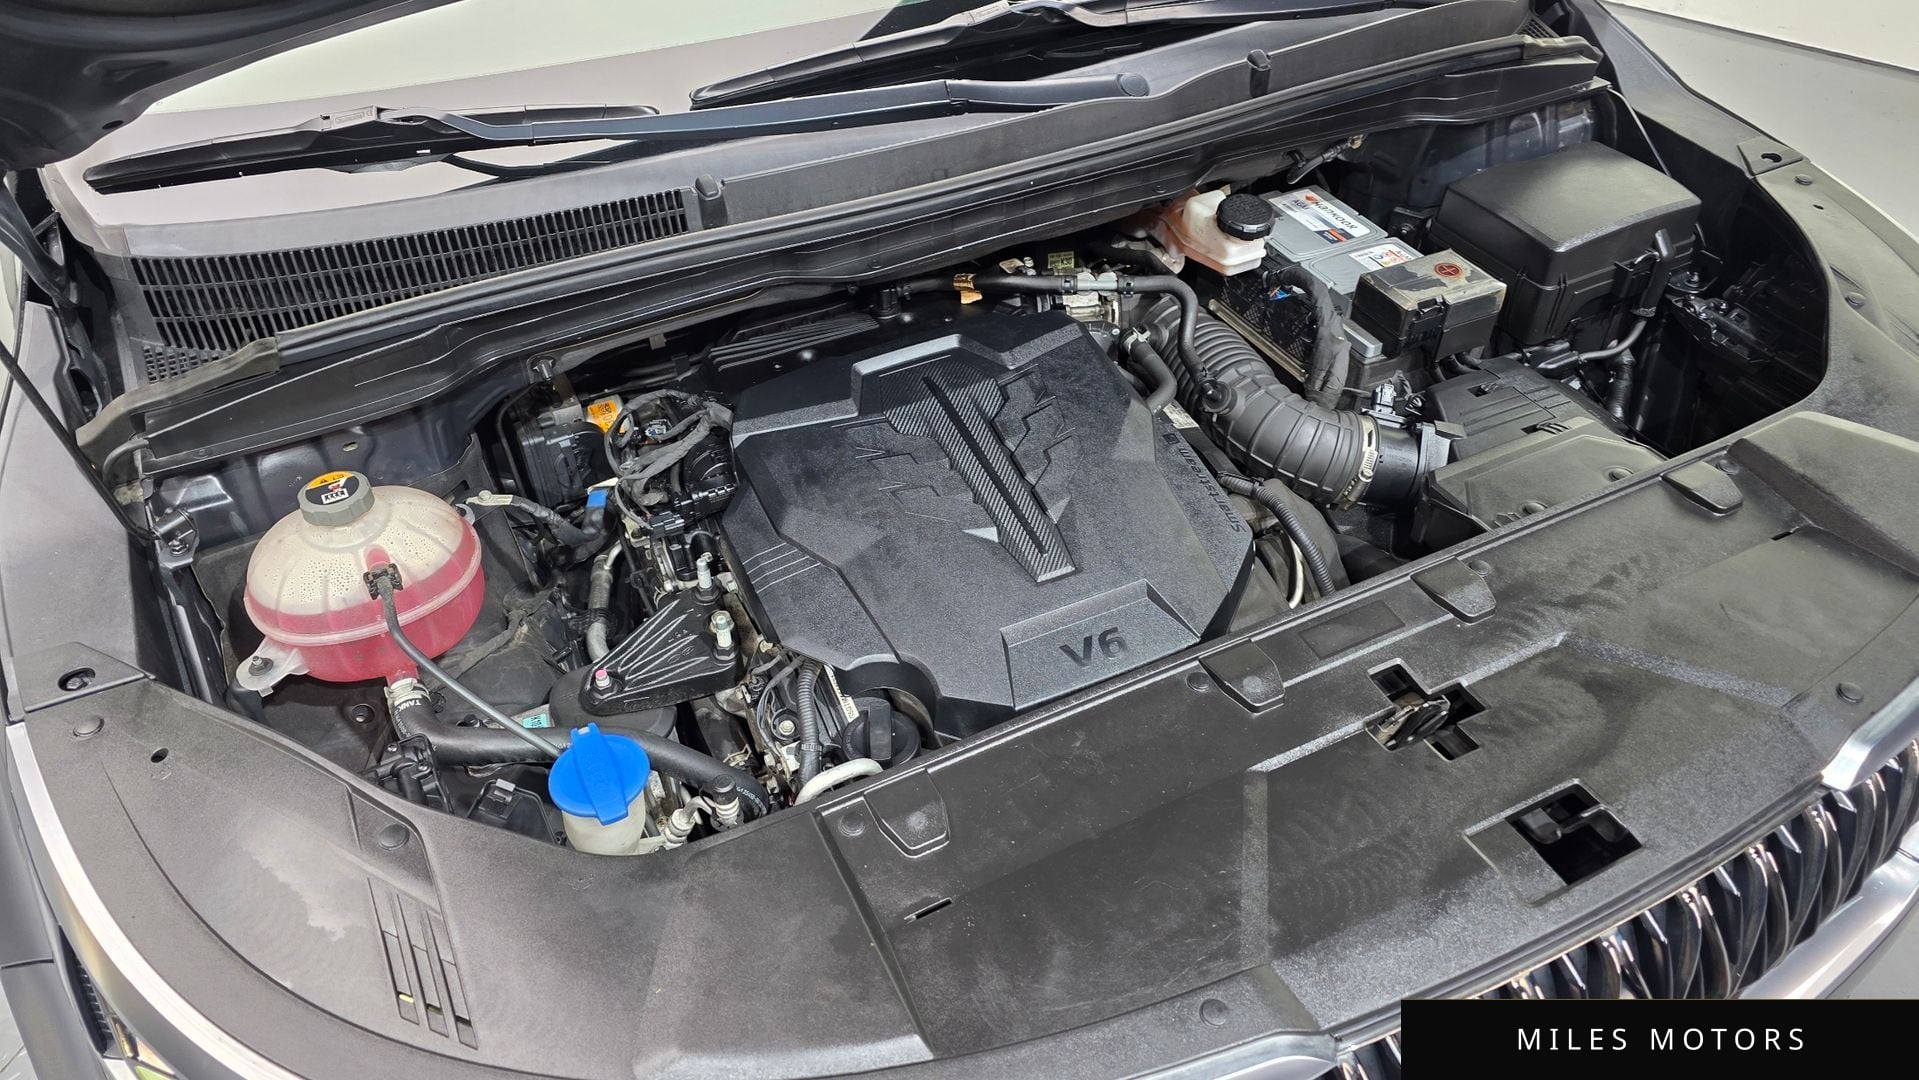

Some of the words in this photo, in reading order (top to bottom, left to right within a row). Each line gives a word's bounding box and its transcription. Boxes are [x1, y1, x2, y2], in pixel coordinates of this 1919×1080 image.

[1178, 446, 1247, 533] Smartstream
[1059, 626, 1128, 667] V6
[397, 699, 422, 712] TANK
